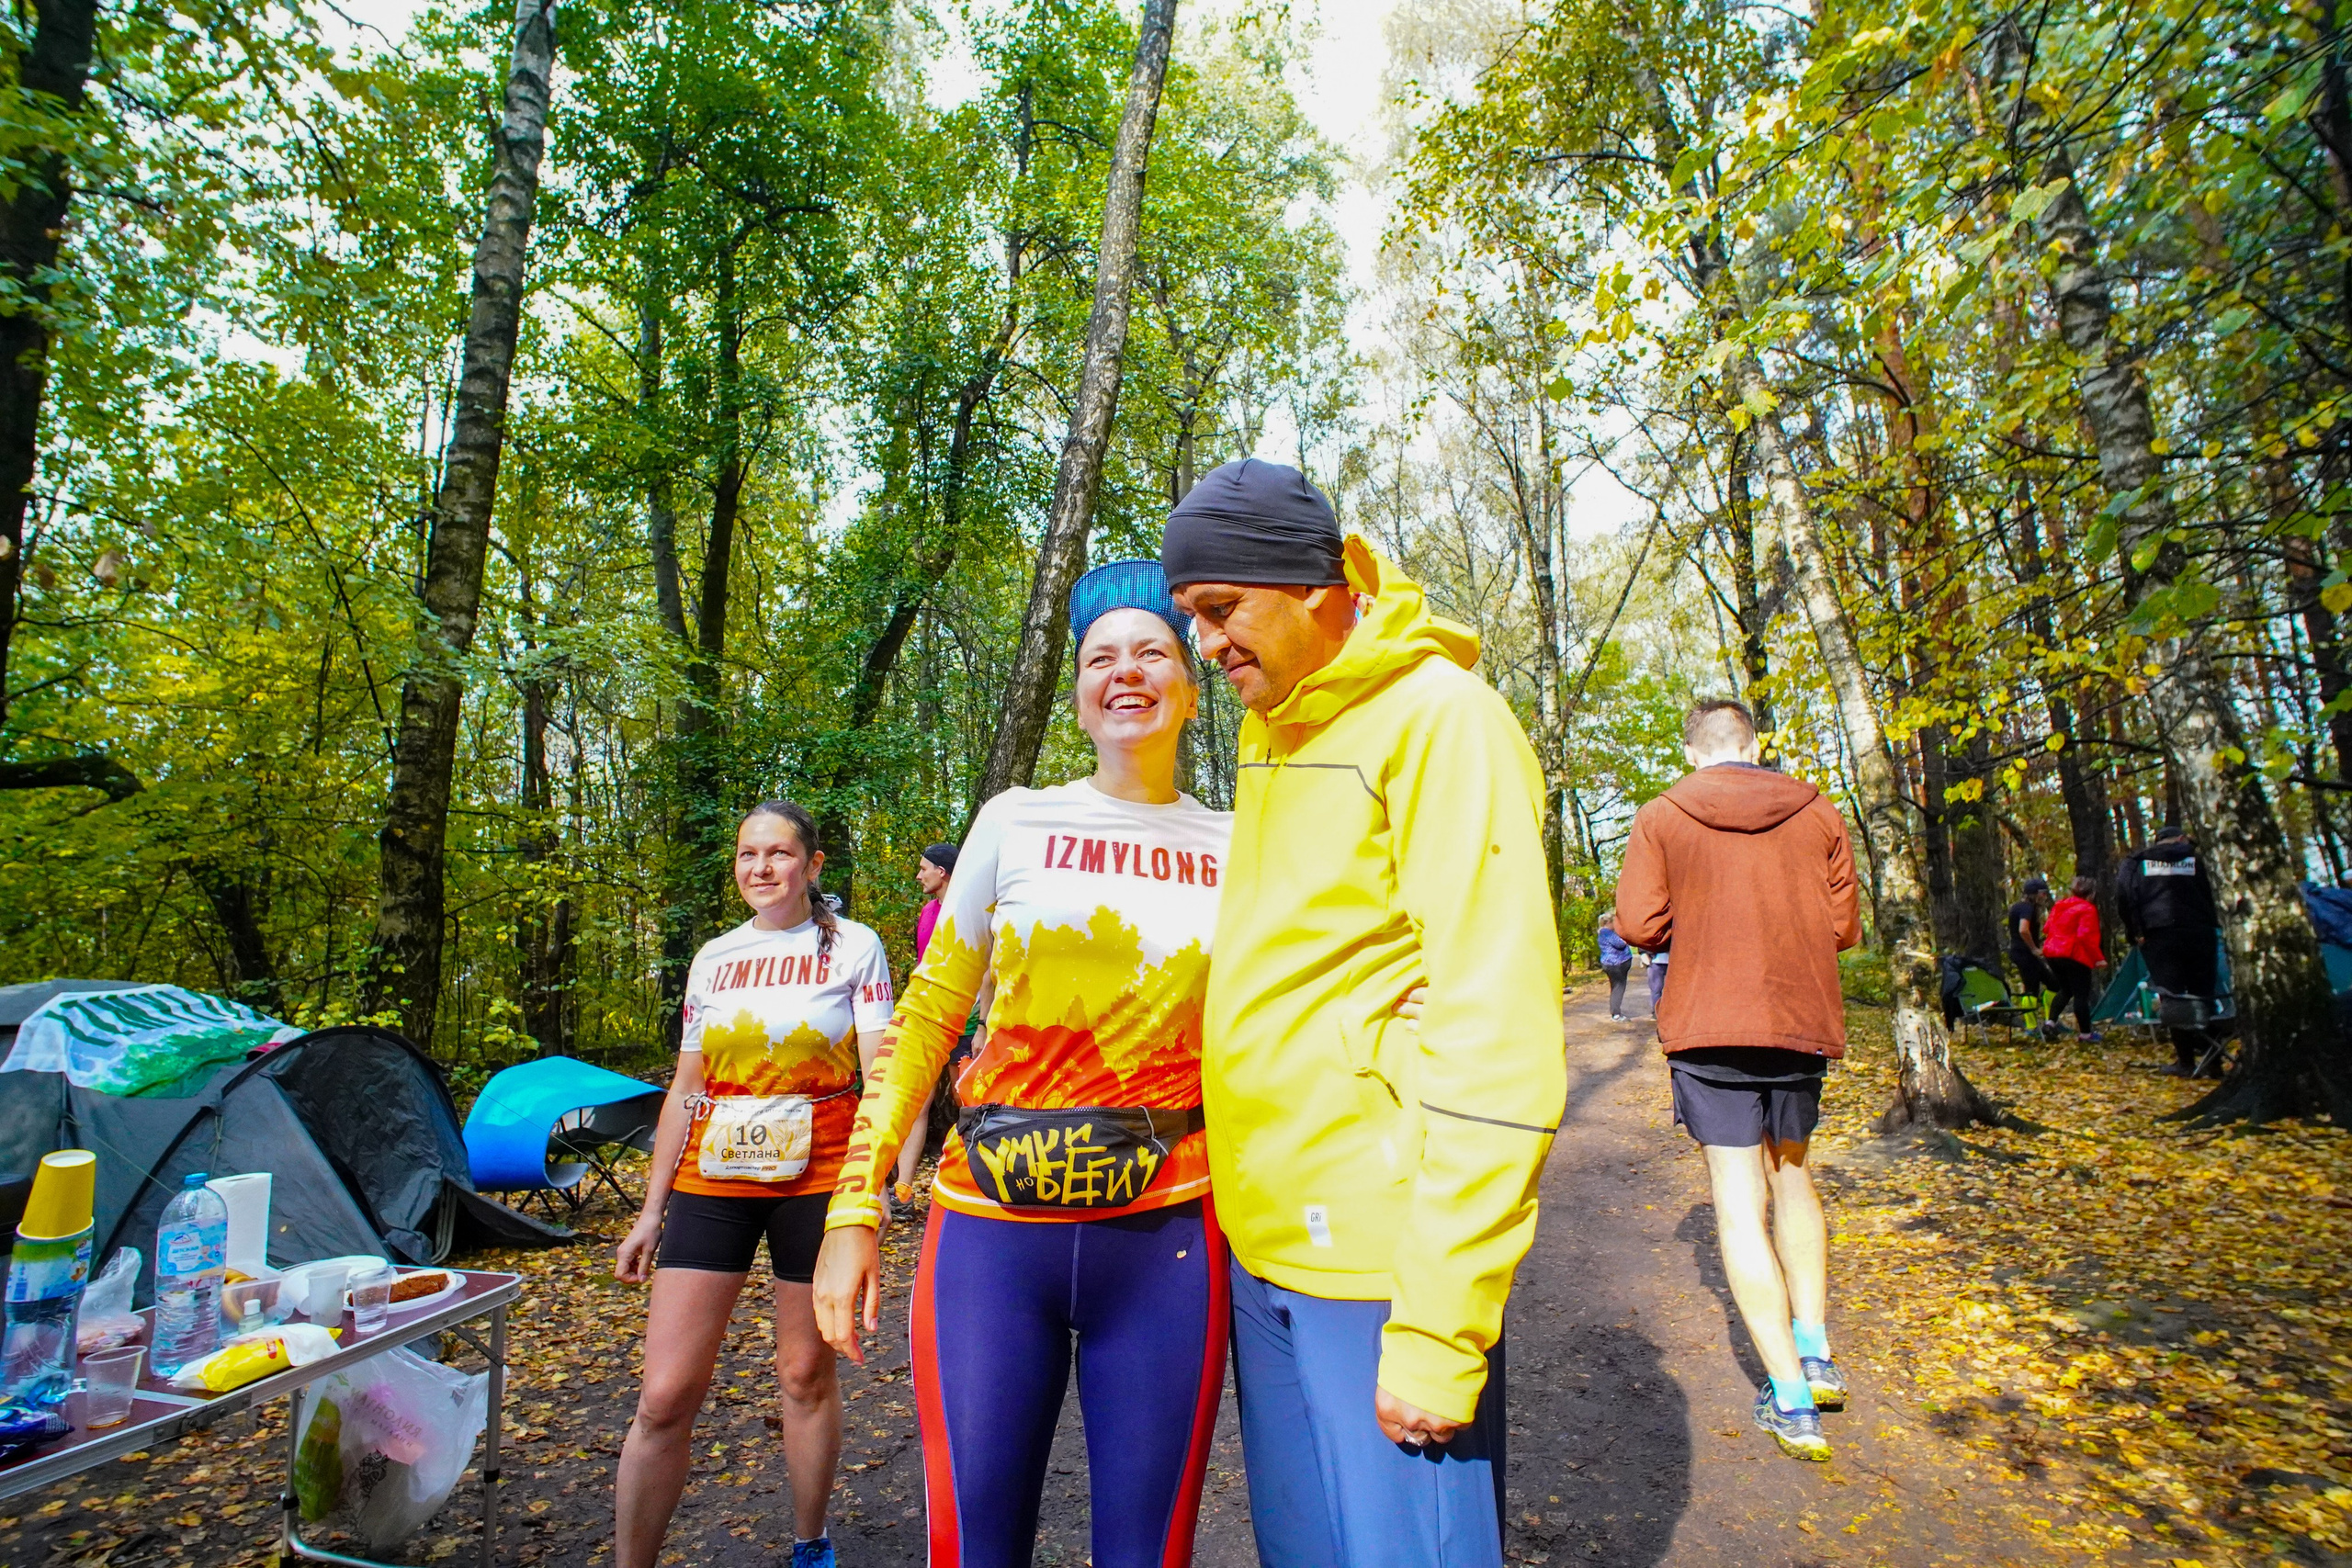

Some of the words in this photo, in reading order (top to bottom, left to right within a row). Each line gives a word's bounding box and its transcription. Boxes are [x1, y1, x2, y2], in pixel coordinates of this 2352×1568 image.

[1045, 835, 1217, 887] IZMYLONG
[712, 953, 831, 993] IZMYLONG
[863, 982, 893, 1003] MOS
[736, 1123, 767, 1146] 10
[721, 1148, 780, 1159] Светлана
